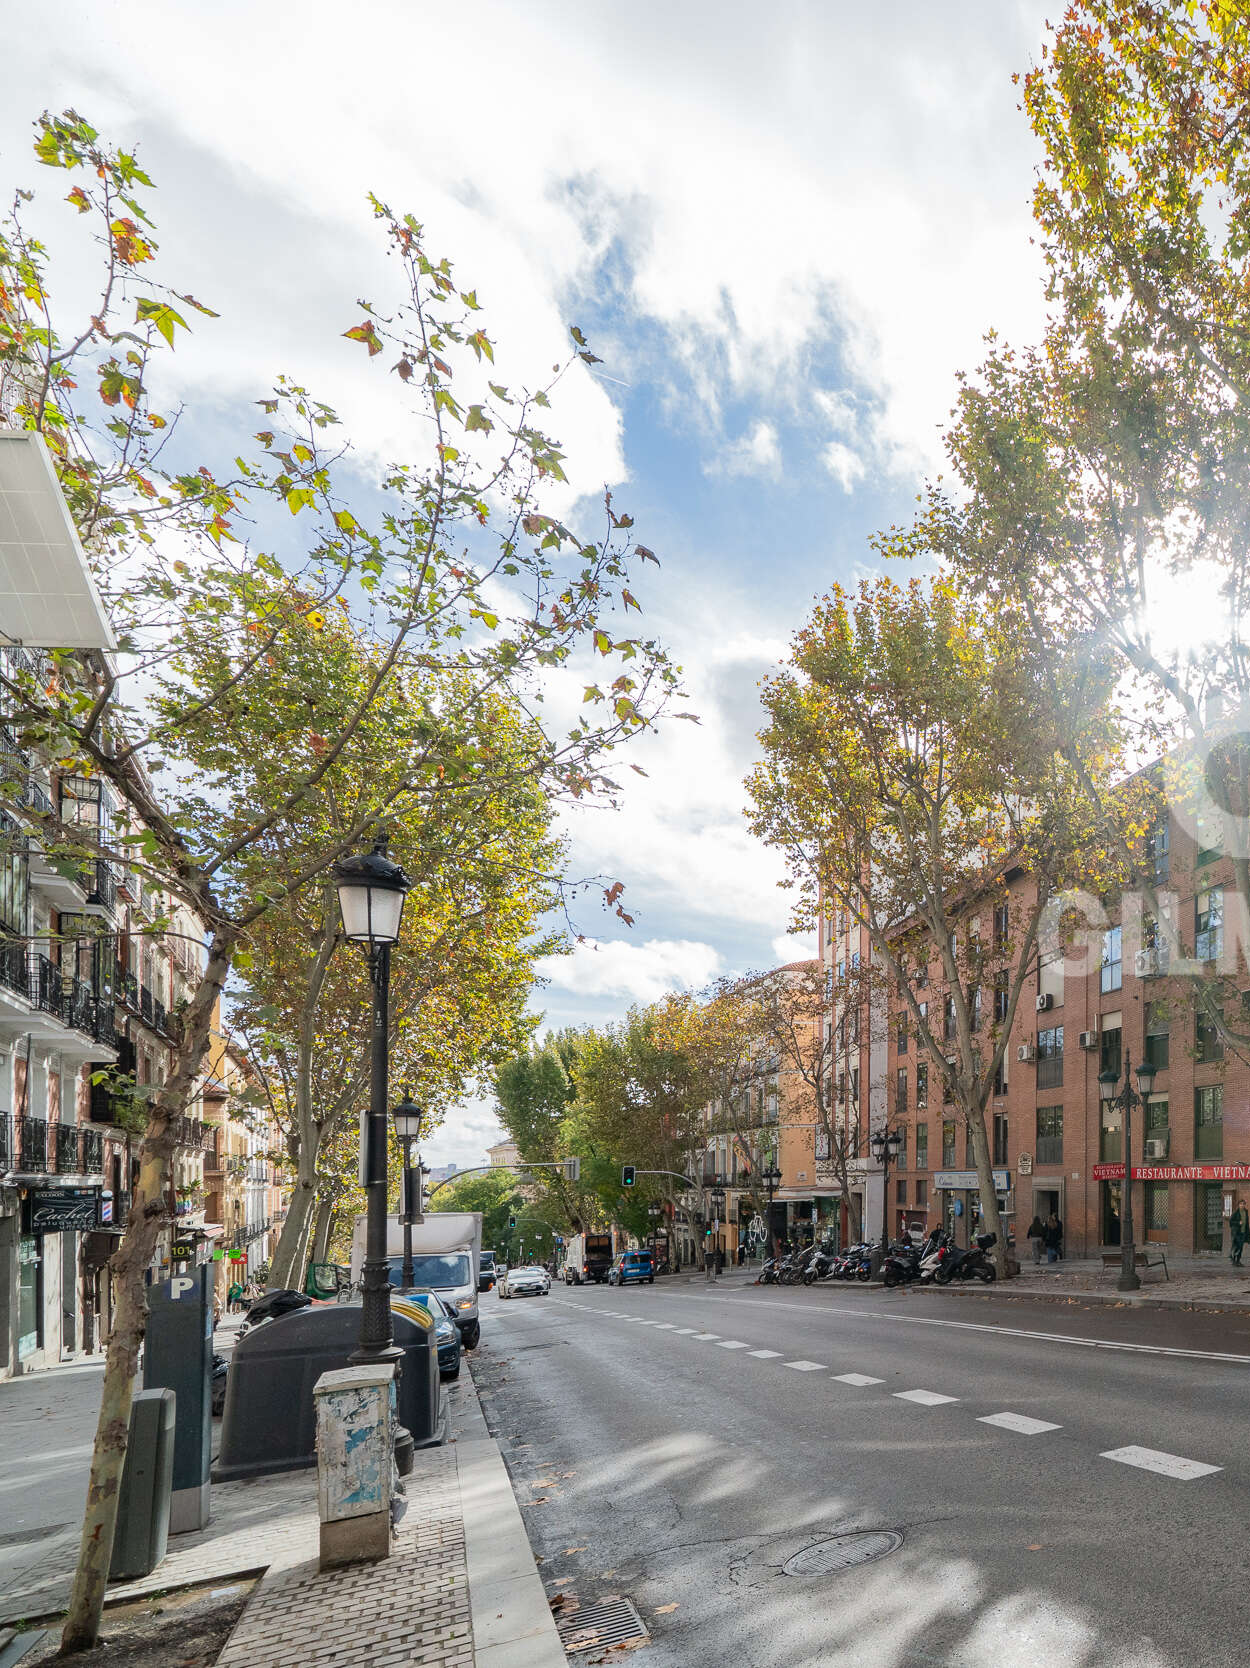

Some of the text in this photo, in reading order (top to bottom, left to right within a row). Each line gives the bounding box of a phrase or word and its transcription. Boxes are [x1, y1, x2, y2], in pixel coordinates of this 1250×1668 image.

[1094, 1167, 1126, 1177] VIETNAM
[1136, 1166, 1203, 1179] RESTAURANTE
[171, 1246, 190, 1256] 101
[171, 1277, 194, 1300] P
